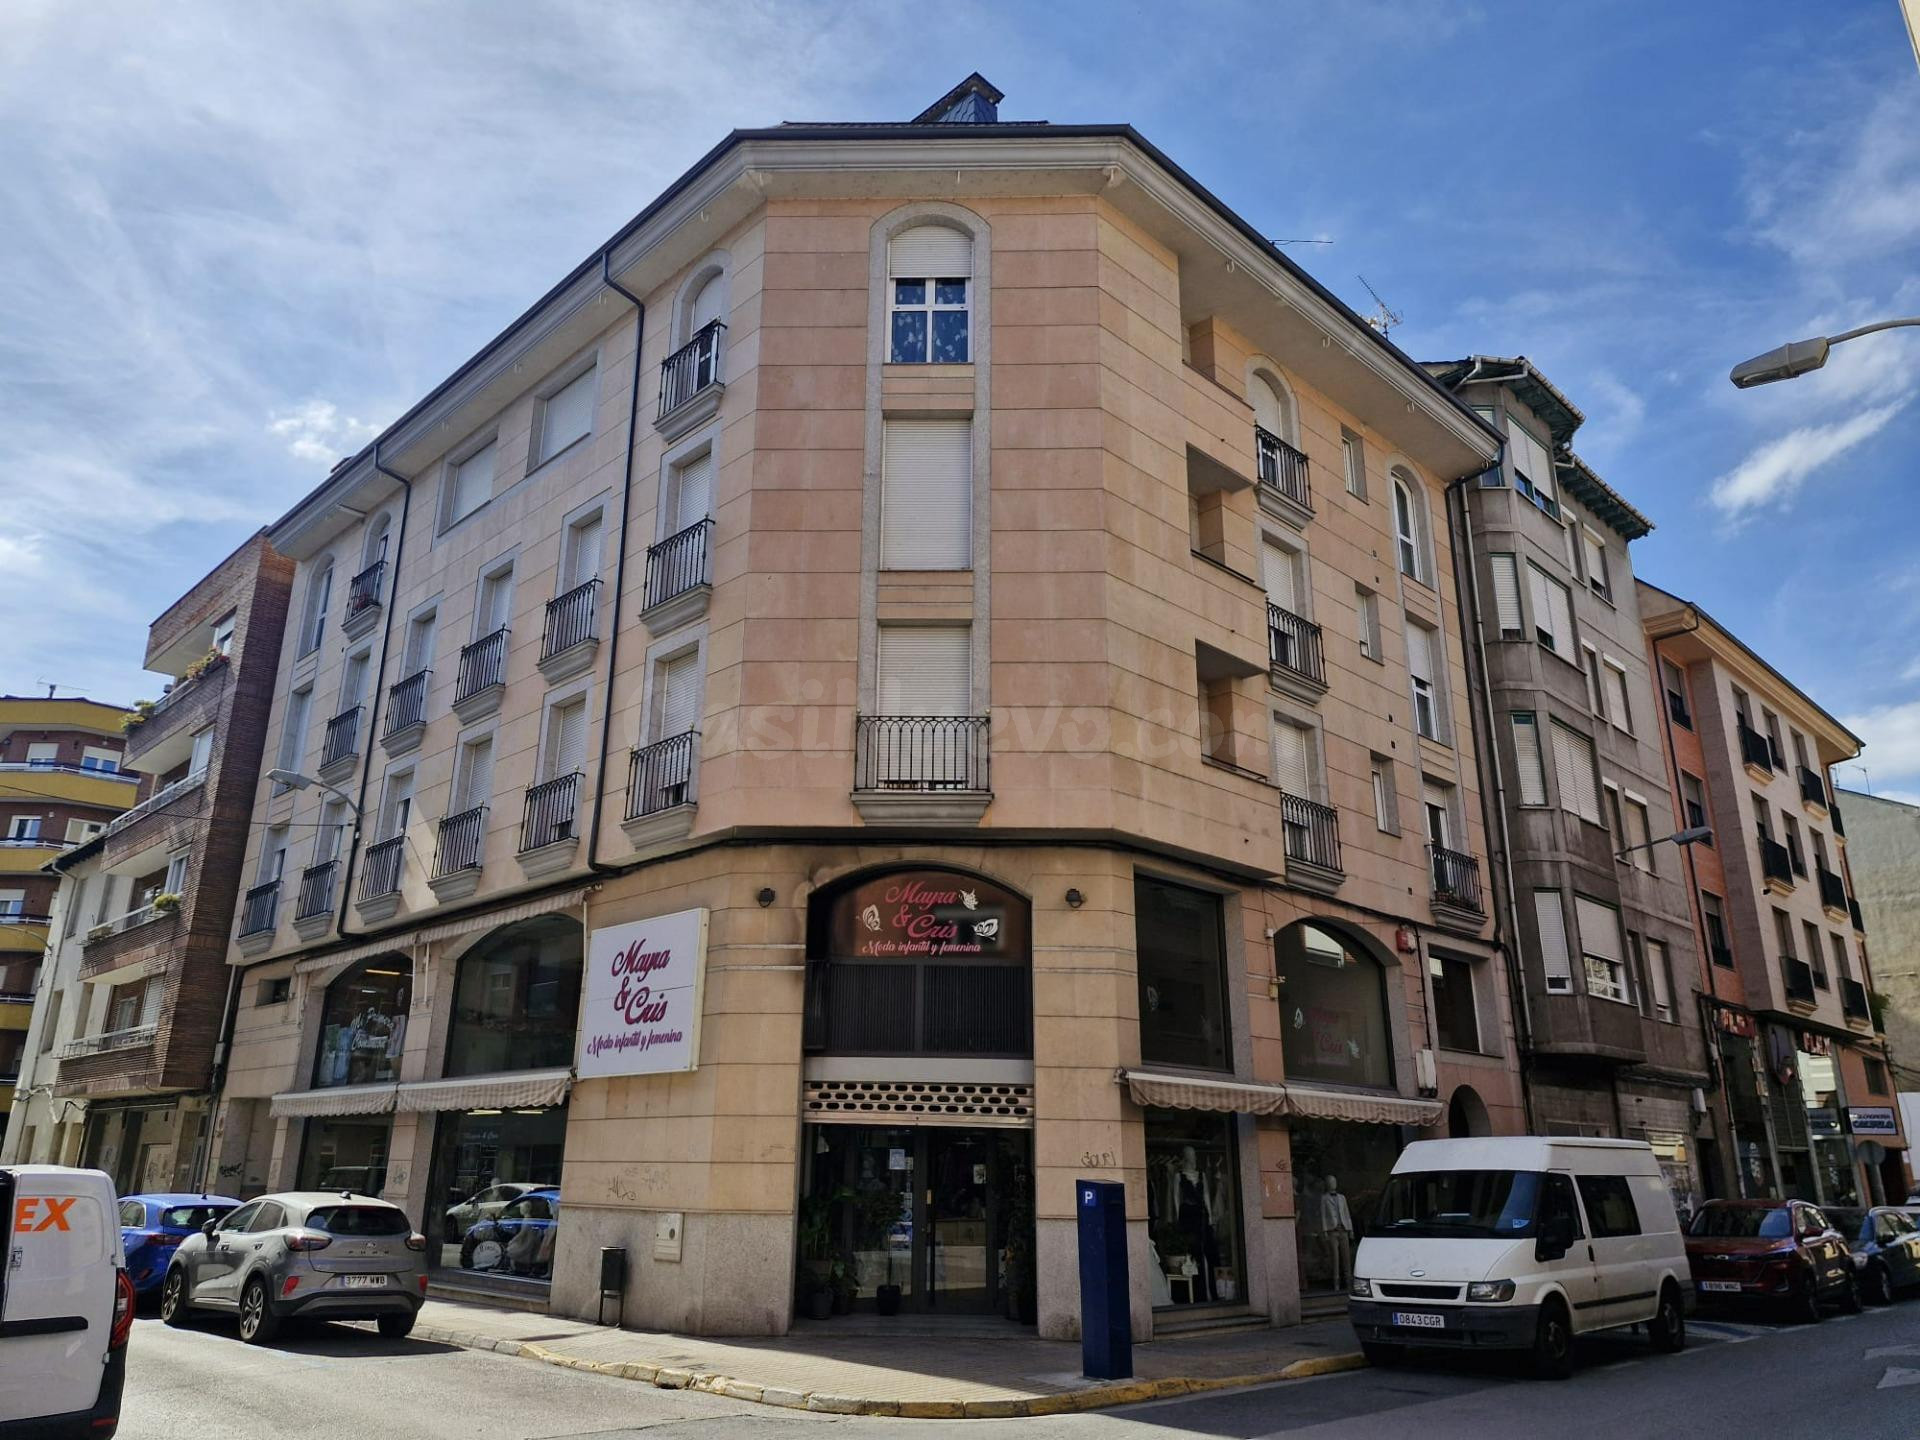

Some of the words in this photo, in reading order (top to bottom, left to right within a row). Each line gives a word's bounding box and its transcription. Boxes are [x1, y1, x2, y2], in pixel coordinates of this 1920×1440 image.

[885, 881, 958, 910] Mayra
[892, 904, 913, 928] &
[907, 914, 958, 938] Cris
[611, 938, 671, 982] Mayra
[863, 940, 895, 956] Moda
[898, 940, 930, 955] infantil
[930, 944, 937, 955] y
[938, 940, 981, 955] femenina
[614, 976, 631, 1011] &
[625, 986, 669, 1025] Cris
[587, 1031, 613, 1057] Moda
[614, 1030, 641, 1053] infantil
[640, 1036, 647, 1052] y
[646, 1029, 682, 1050] femenina
[1084, 1191, 1093, 1204] P
[14, 1198, 77, 1232] EX
[345, 1275, 367, 1285] 3777
